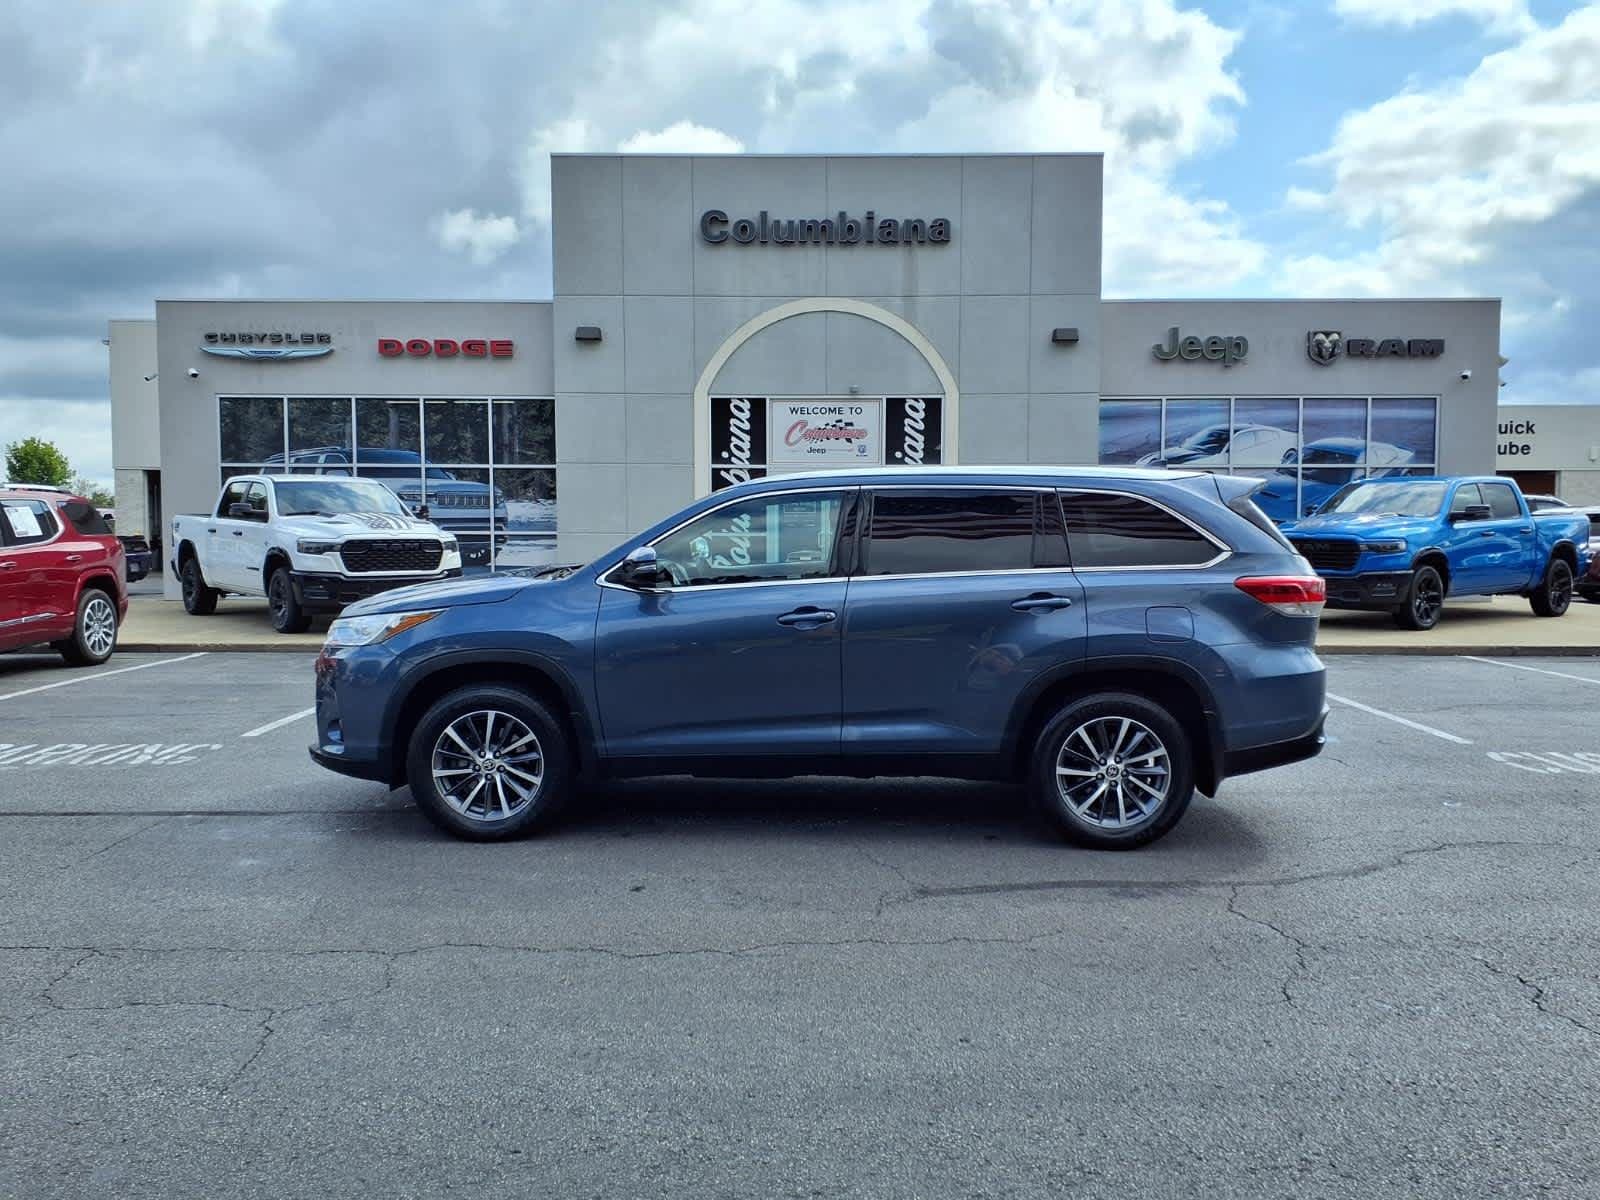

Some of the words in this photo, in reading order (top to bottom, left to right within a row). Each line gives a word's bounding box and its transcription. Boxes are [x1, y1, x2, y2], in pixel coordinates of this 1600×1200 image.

[700, 209, 951, 244] Columbiana
[204, 332, 332, 344] CHRYSLER
[378, 338, 514, 358] DODGE
[1152, 327, 1249, 367] Jeep
[1346, 338, 1445, 359] RAM
[789, 406, 844, 415] WELCOME
[848, 406, 863, 415] TO
[1498, 420, 1536, 435] uick
[1497, 441, 1531, 456] ube
